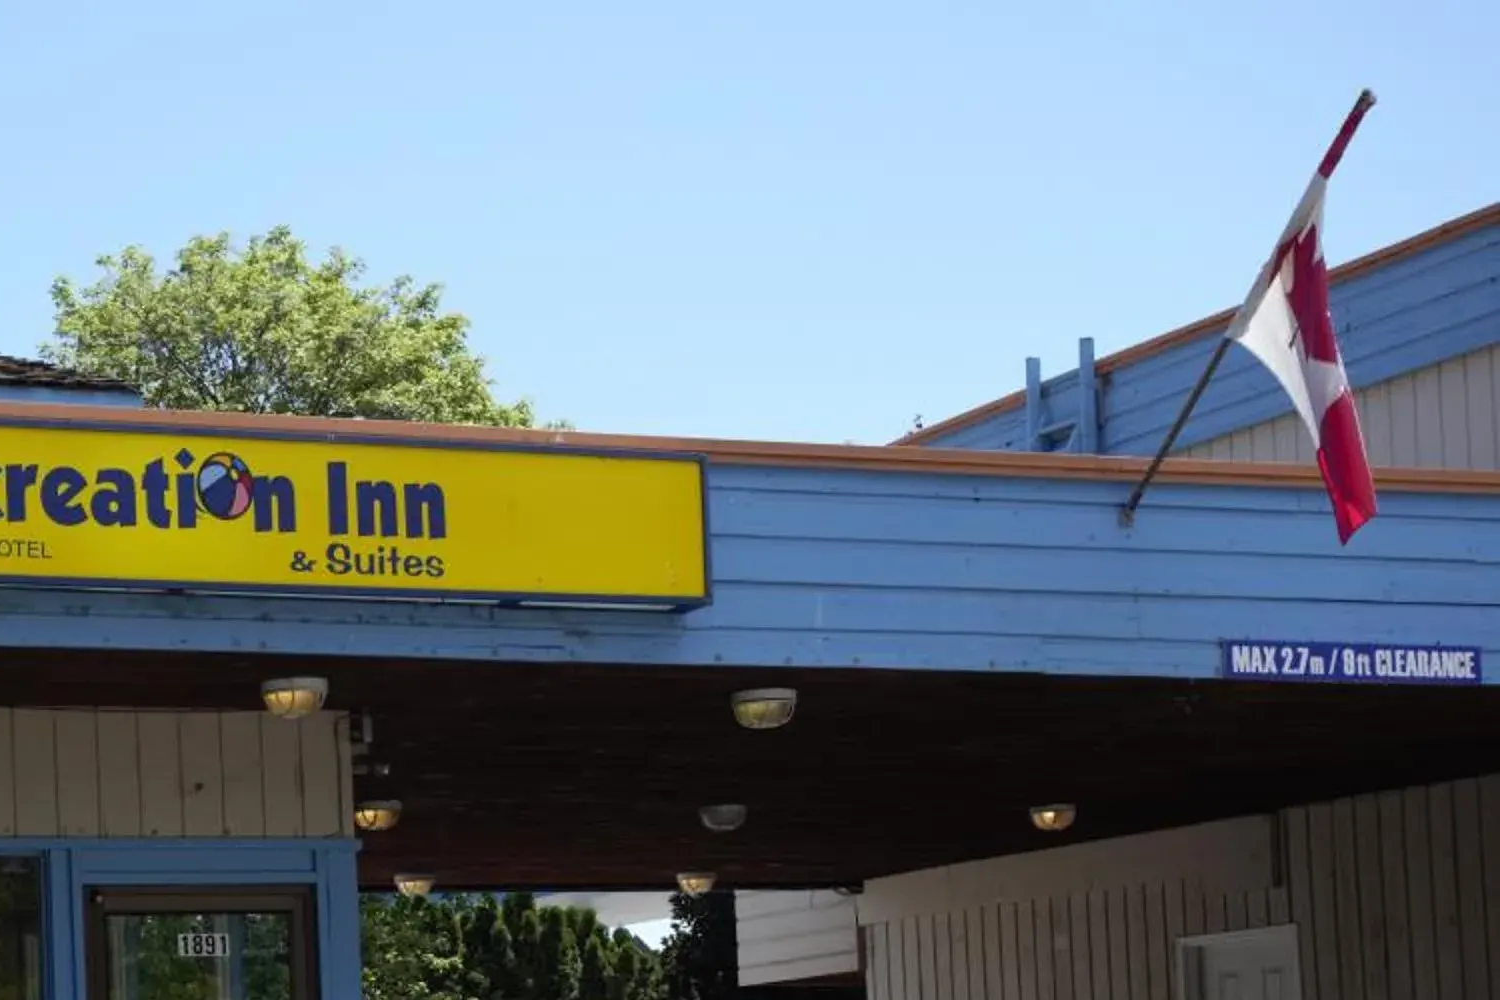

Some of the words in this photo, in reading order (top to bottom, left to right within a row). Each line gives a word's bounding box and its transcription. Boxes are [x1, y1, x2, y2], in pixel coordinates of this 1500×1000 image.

[327, 461, 447, 539] Inn
[290, 551, 317, 572] &
[326, 543, 445, 577] Suites
[1232, 645, 1278, 674] MAX
[1327, 648, 1339, 675] /
[1375, 649, 1477, 678] CLEARANCE
[182, 935, 227, 955] 1891
